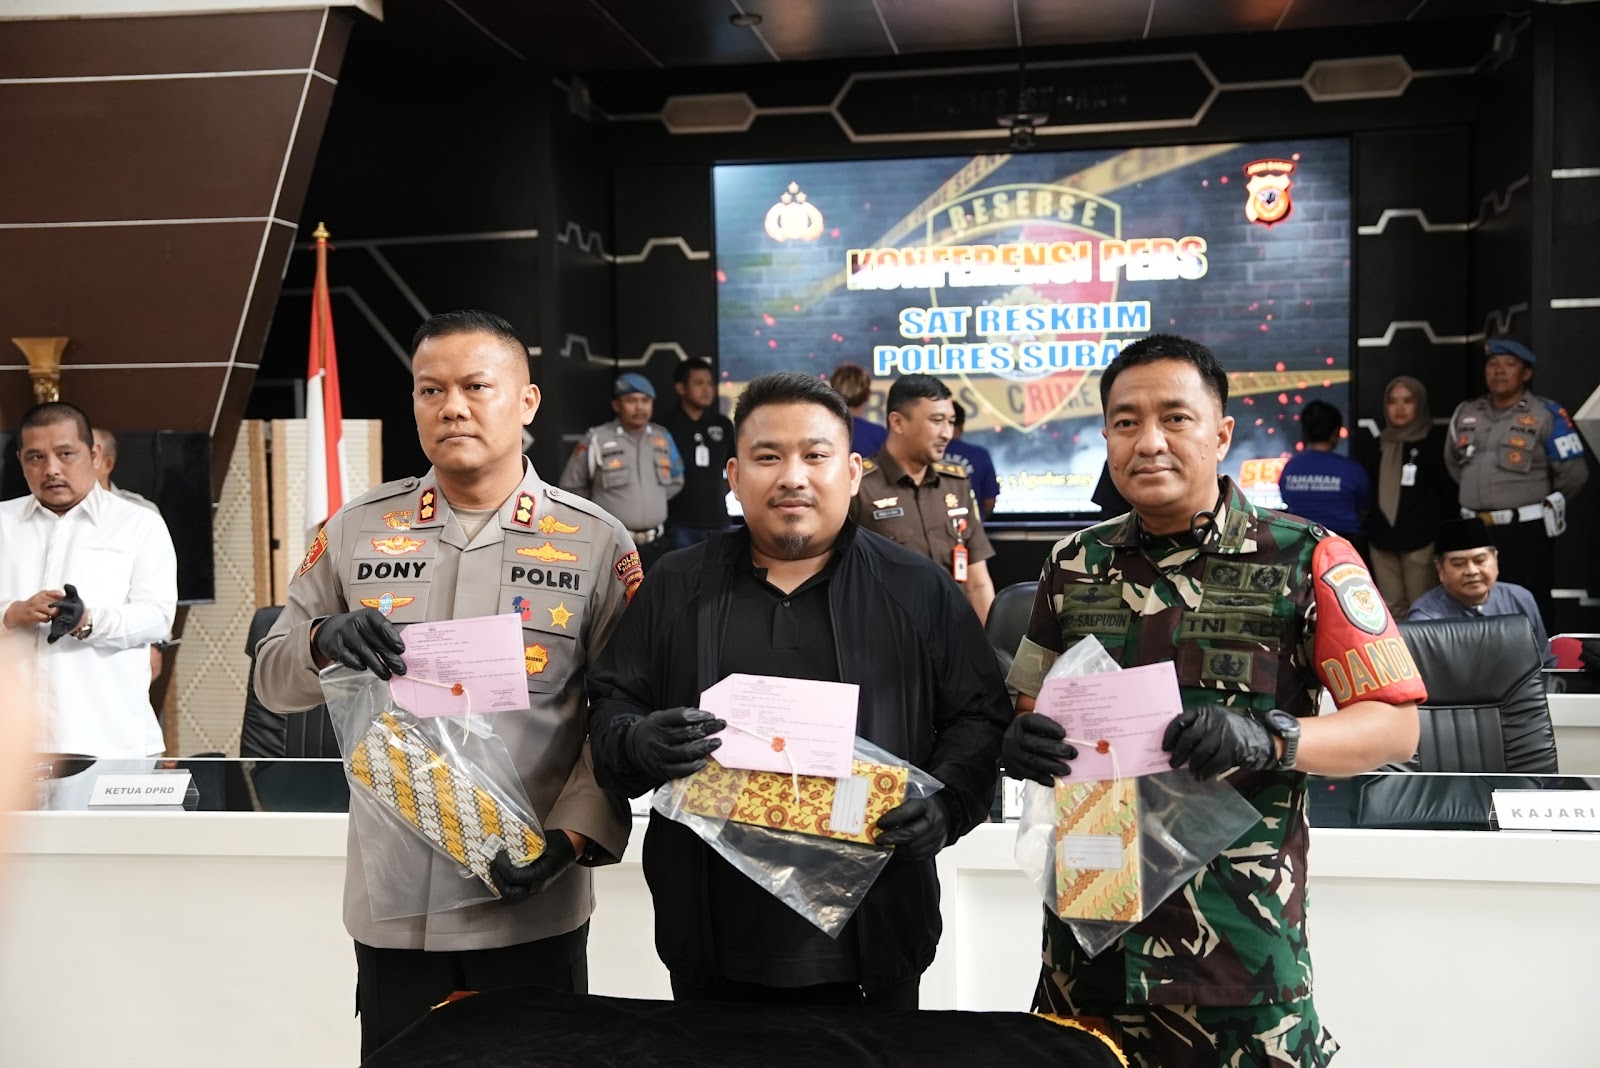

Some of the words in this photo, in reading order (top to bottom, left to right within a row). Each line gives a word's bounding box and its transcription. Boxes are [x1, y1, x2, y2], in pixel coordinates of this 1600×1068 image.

[948, 190, 1099, 232] RESERSE
[847, 241, 1093, 290] KONFERENSI
[1100, 236, 1208, 283] PERS
[899, 306, 972, 338] SAT
[976, 301, 1151, 336] RESKRIM
[874, 343, 1014, 376] POLRES
[1019, 340, 1134, 373] SUBA
[357, 562, 427, 580] DONY
[511, 566, 580, 591] POLRI
[1186, 618, 1226, 633] TNI
[1239, 620, 1278, 637] AD
[1321, 636, 1421, 704] DAND
[104, 787, 142, 796] KETUA
[145, 786, 175, 795] DPRD
[1511, 808, 1596, 819] KAJARI
